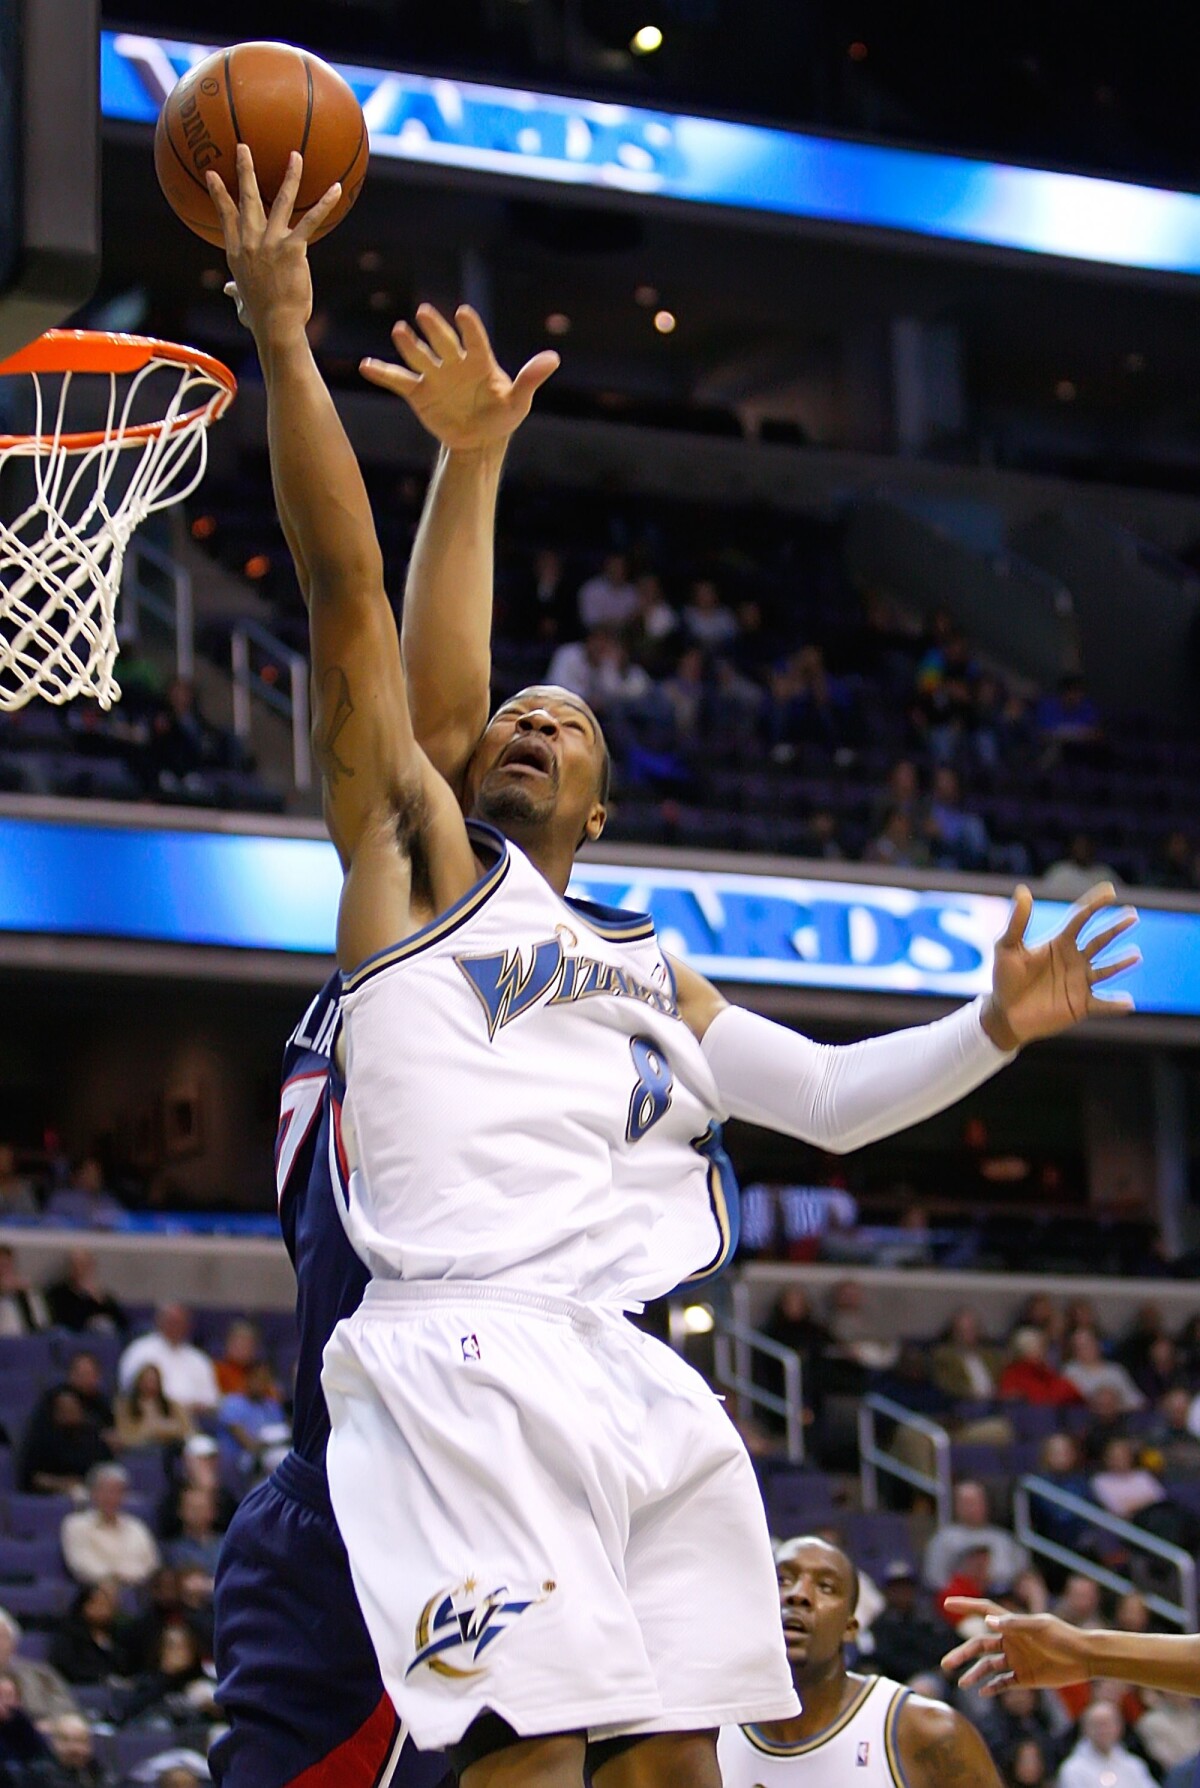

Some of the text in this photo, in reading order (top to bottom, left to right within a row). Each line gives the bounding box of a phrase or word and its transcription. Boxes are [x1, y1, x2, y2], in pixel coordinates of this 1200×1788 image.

[179, 82, 223, 169] DING
[286, 994, 340, 1058] LIA
[625, 1034, 673, 1143] 8
